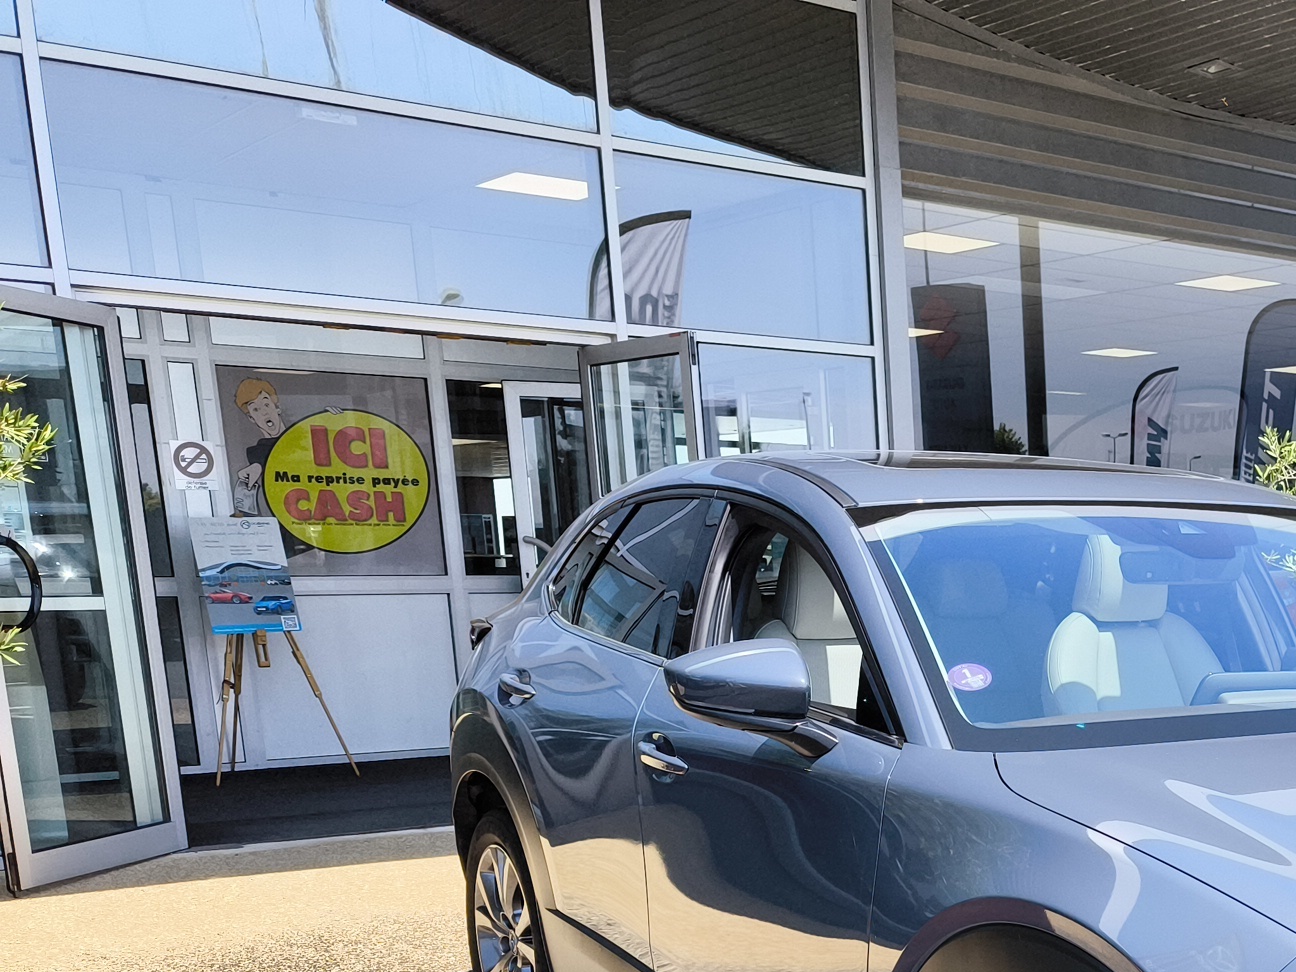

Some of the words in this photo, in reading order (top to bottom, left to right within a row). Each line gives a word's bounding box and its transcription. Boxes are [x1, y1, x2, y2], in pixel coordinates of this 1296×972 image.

[310, 424, 389, 469] ICI
[274, 471, 301, 483] Ma
[307, 473, 366, 486] reprise
[372, 475, 420, 488] payée
[283, 488, 407, 523] CASH
